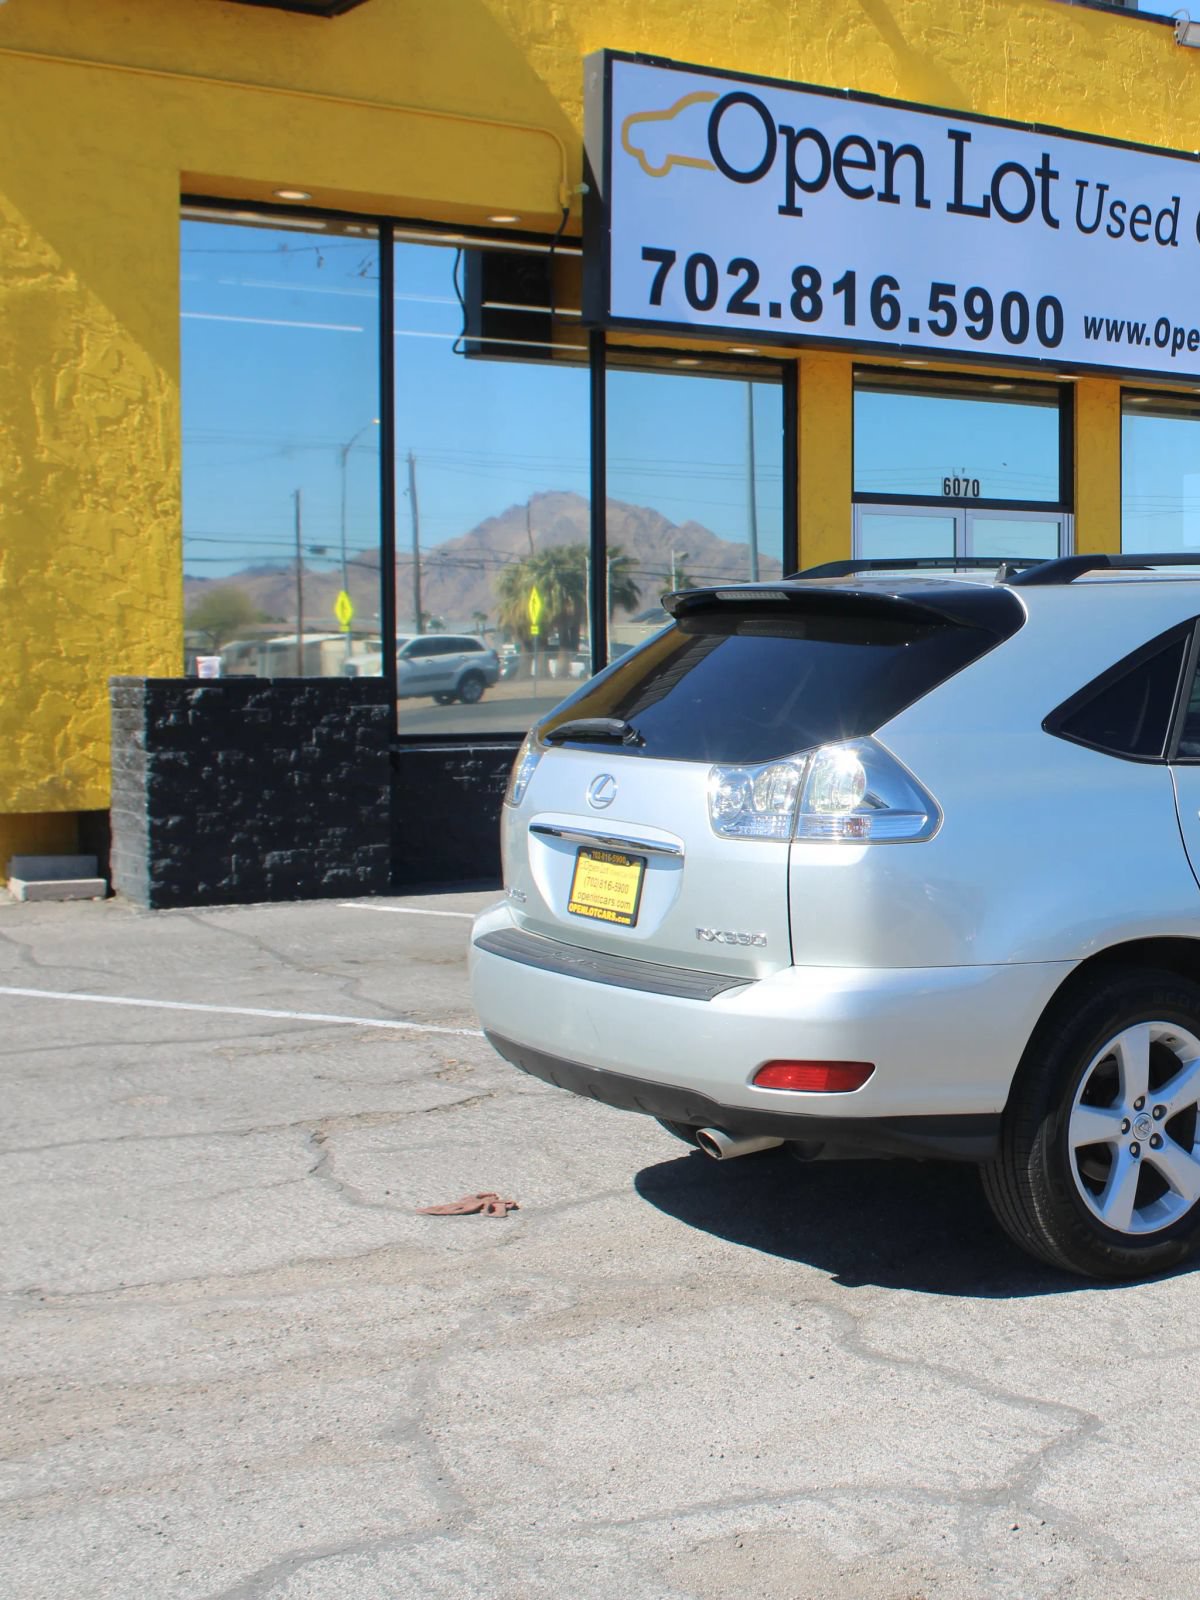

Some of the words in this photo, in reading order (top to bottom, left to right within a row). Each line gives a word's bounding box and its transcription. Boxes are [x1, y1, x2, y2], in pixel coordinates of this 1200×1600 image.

[708, 91, 931, 217] Open
[946, 128, 1060, 229] Lot
[1075, 180, 1181, 247] Used
[641, 246, 1064, 349] 702.816.5900
[944, 477, 980, 498] 6070
